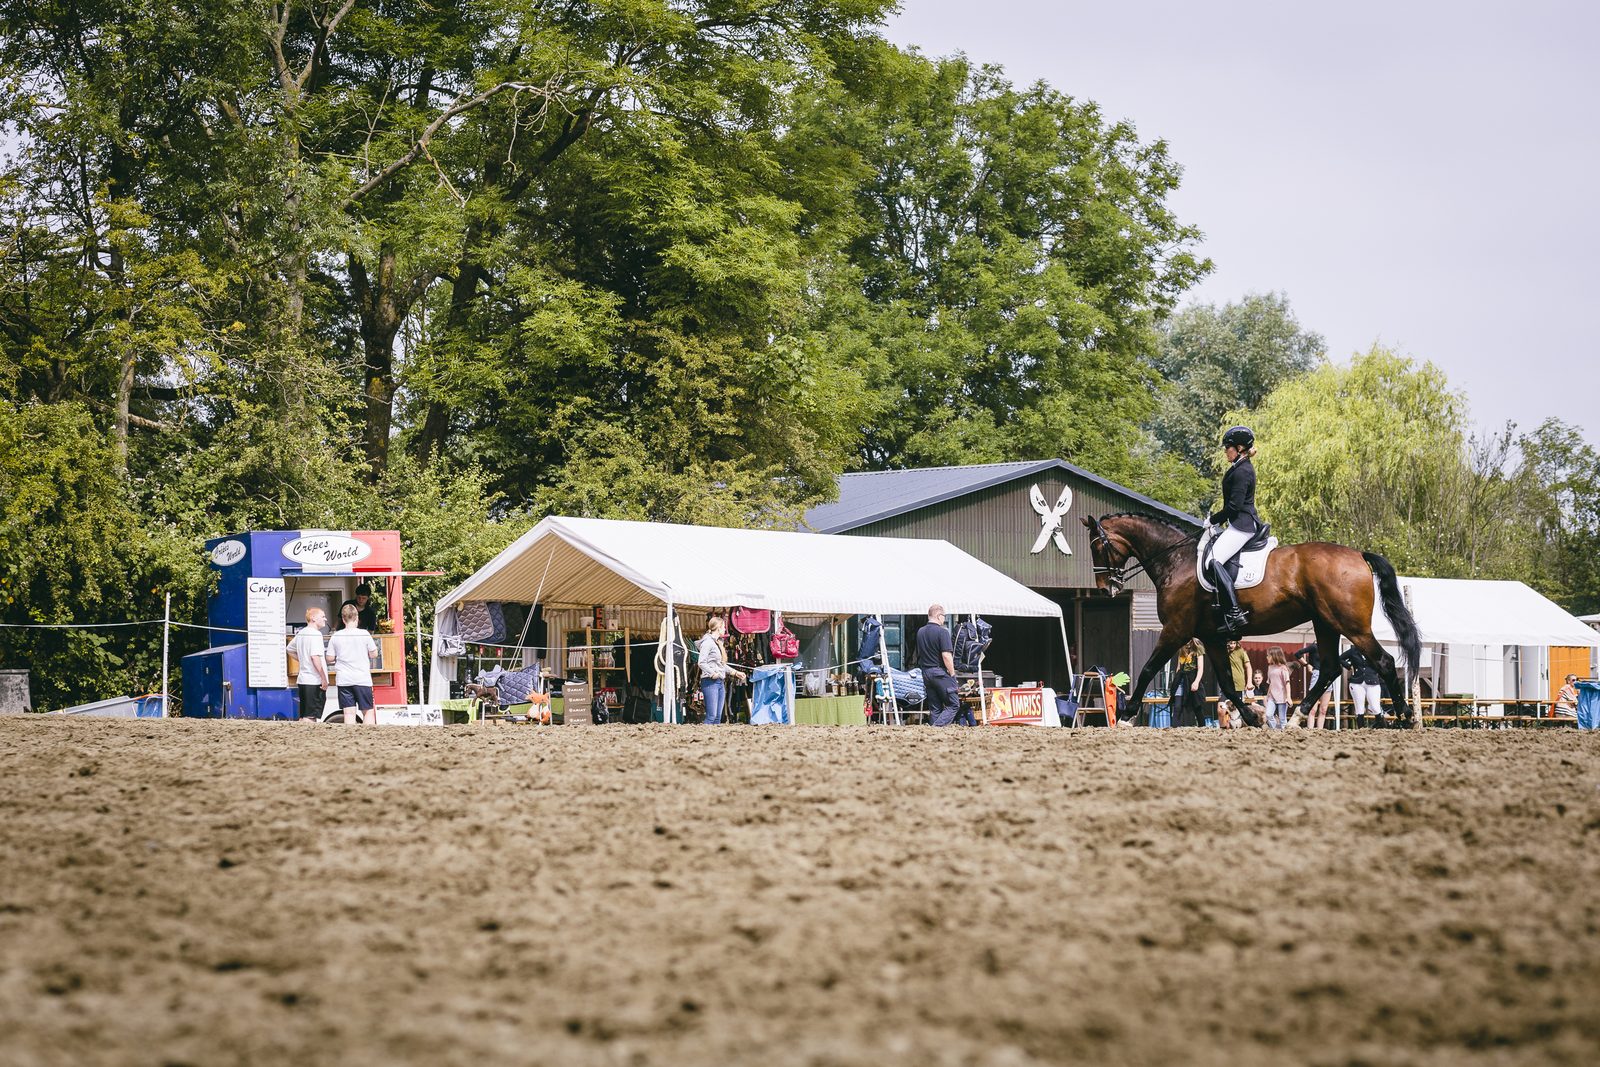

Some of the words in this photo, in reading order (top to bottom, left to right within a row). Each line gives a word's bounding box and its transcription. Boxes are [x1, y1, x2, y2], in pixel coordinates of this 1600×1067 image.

[292, 540, 329, 556] Crêpes
[323, 546, 359, 562] World
[249, 582, 284, 597] Crêpes
[1012, 694, 1042, 716] IMBISS
